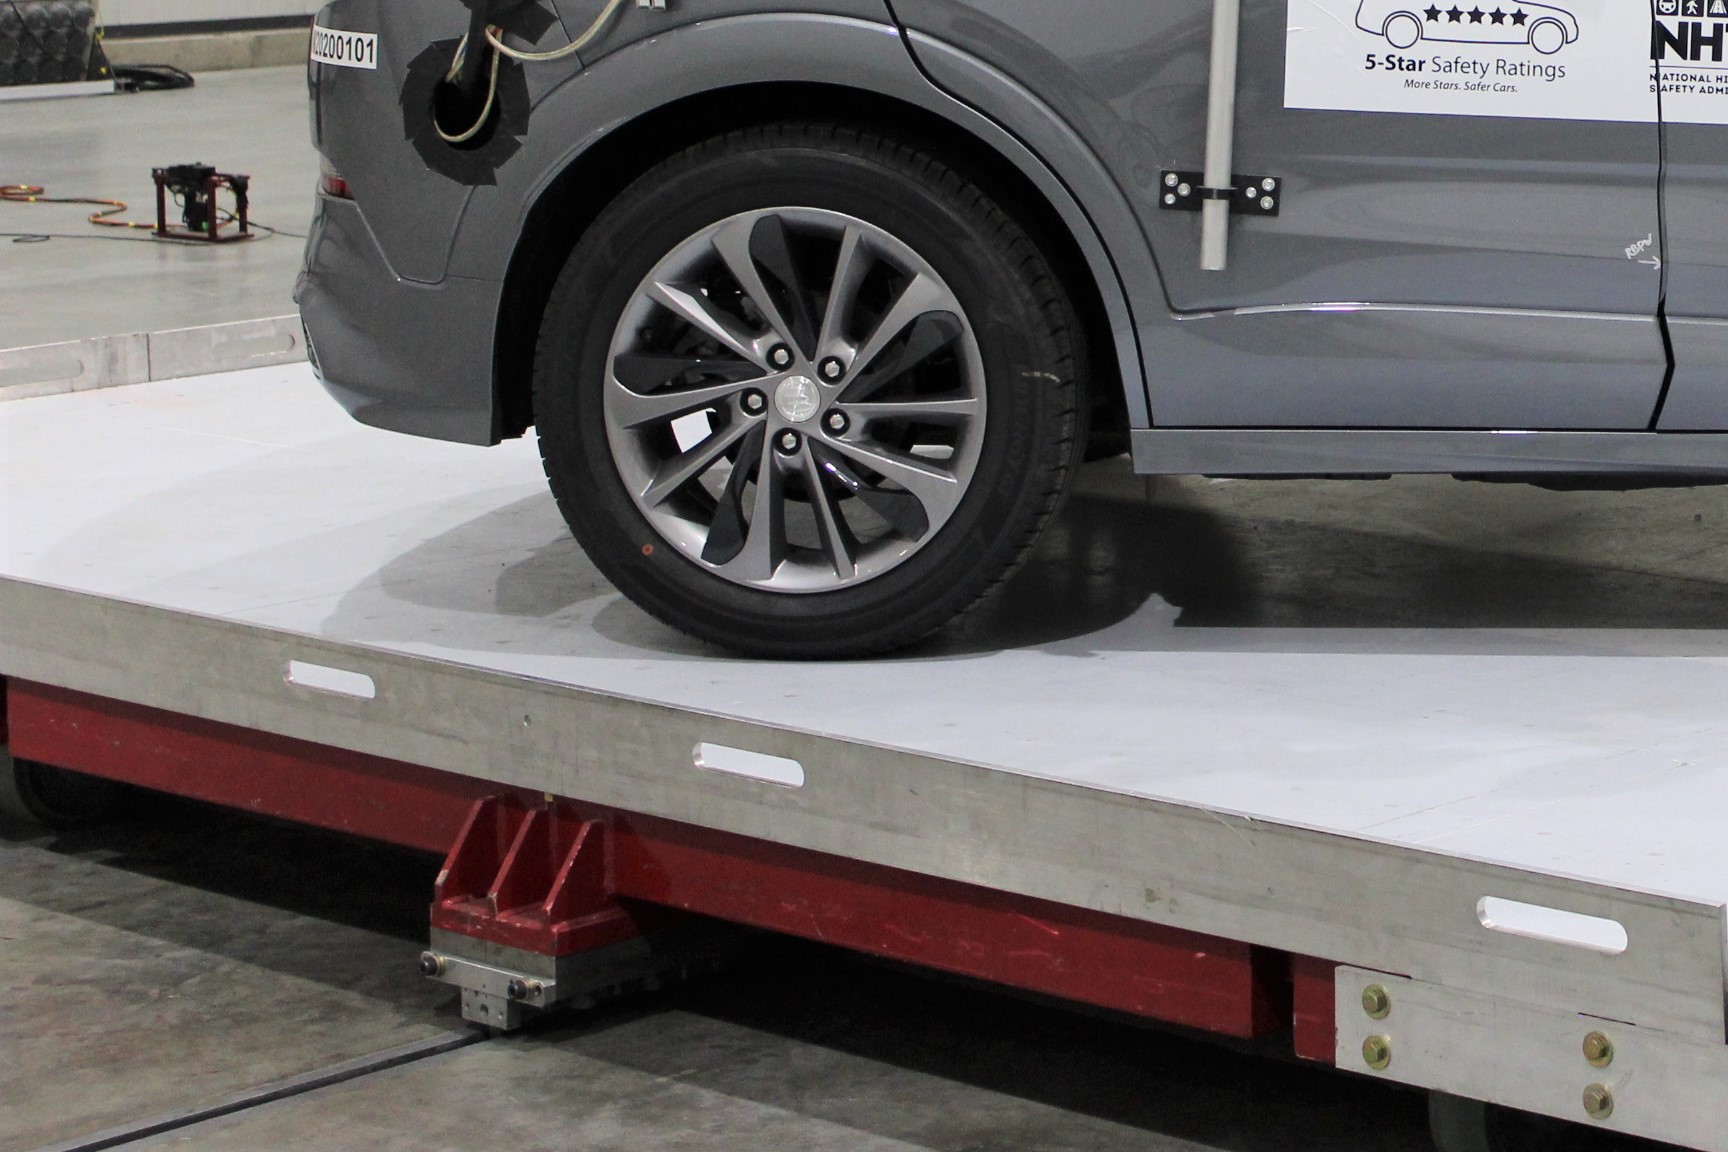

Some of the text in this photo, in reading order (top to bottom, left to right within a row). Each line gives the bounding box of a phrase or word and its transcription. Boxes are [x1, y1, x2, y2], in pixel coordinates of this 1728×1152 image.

[1365, 54, 1566, 82] 5-Star Safety Ratings
[1650, 73, 1711, 83] NATIONAL
[1404, 79, 1518, 92] More Stars. Safer Cars.
[1650, 85, 1695, 93] SAFETY
